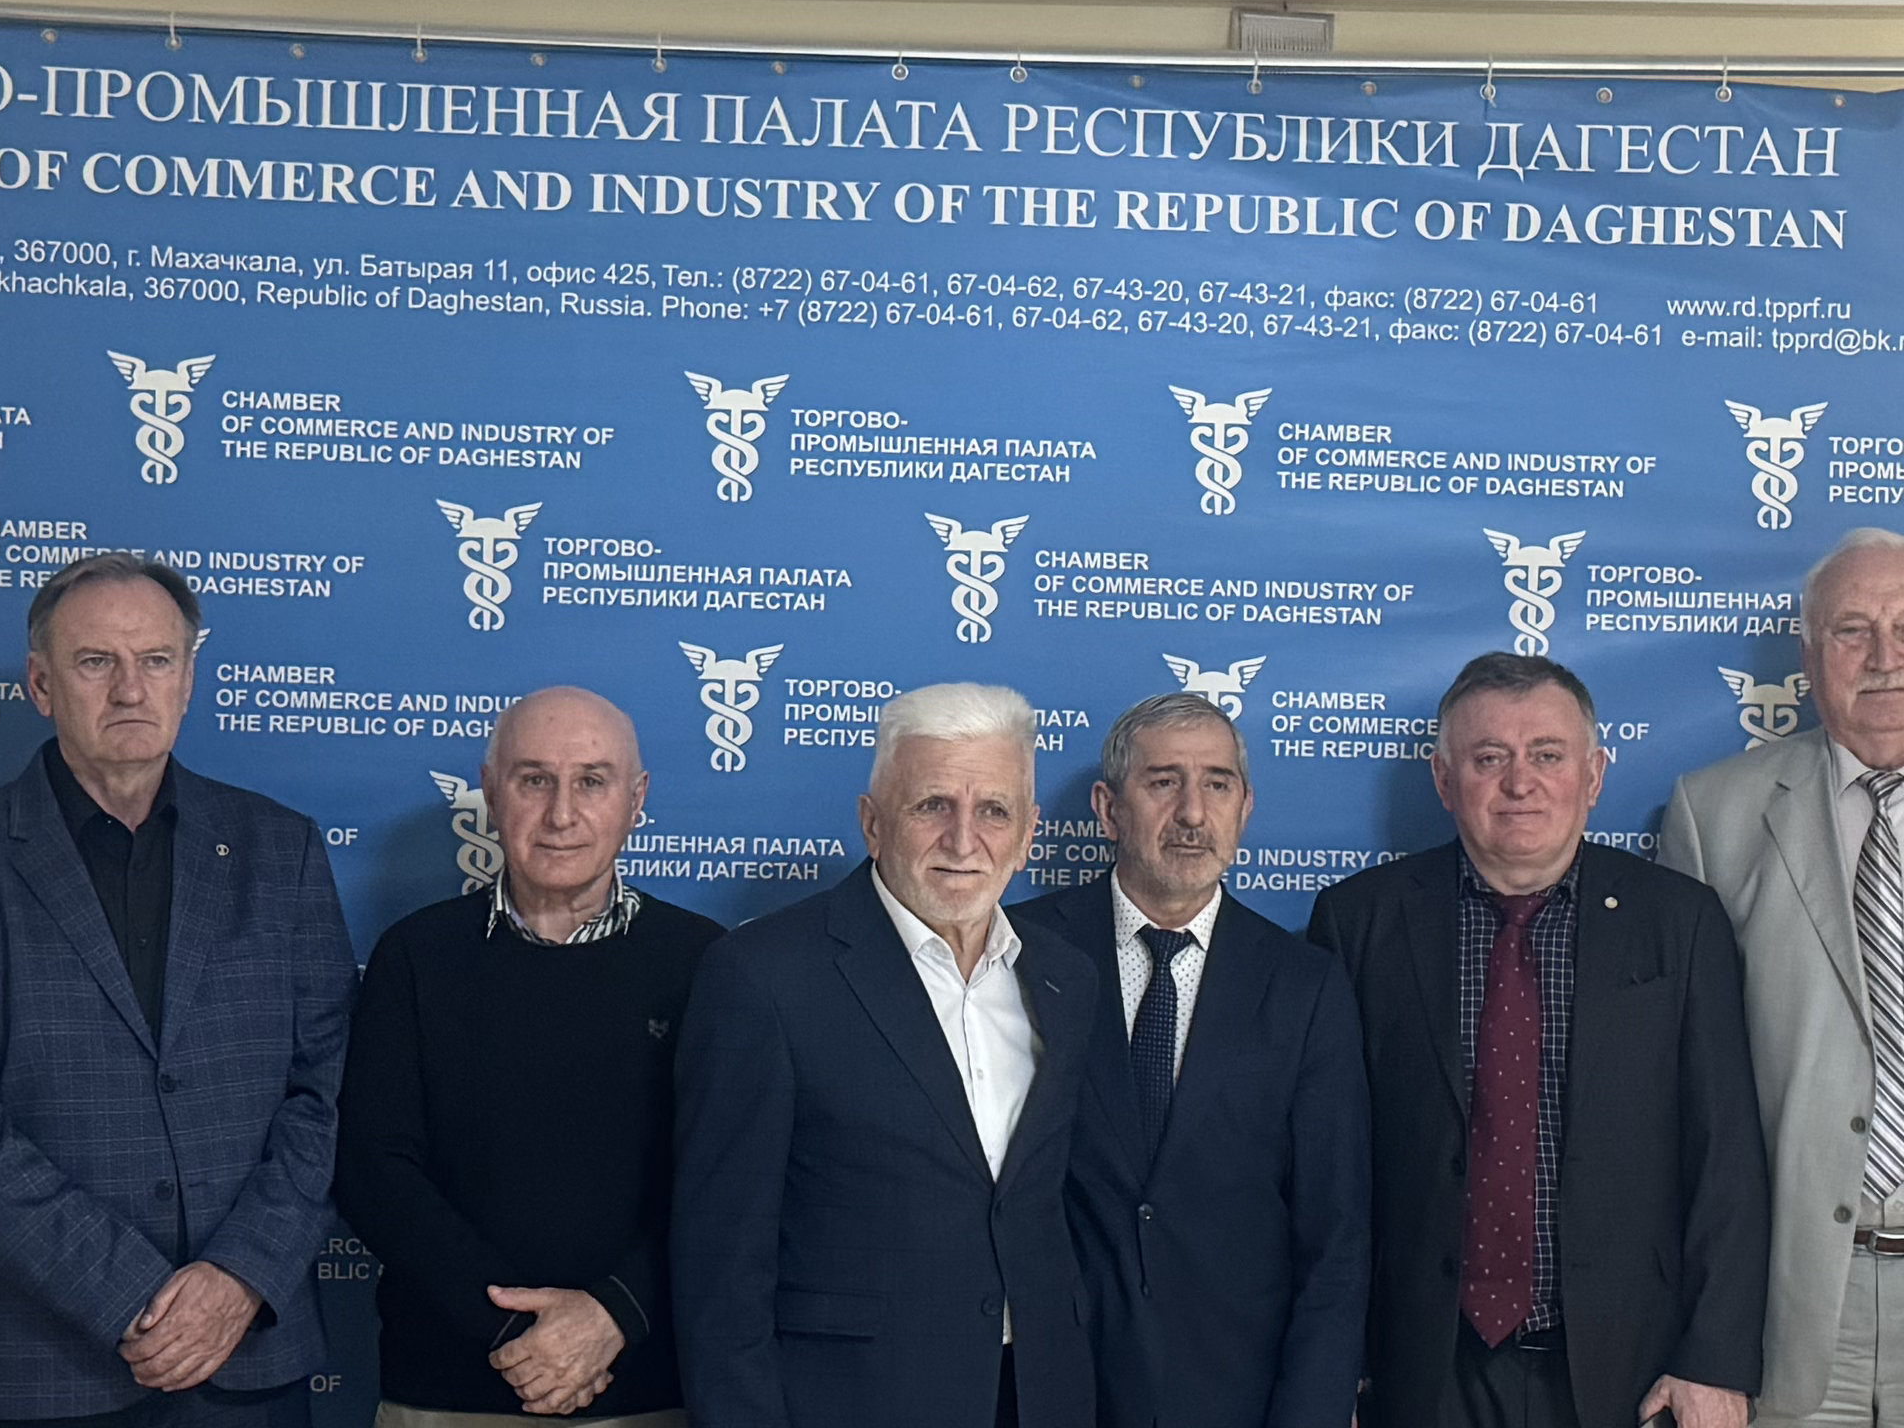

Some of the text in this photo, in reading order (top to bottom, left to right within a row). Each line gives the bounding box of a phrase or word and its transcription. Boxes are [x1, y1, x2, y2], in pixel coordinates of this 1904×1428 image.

[700, 94, 984, 152] ПАЛАТА
[1001, 101, 1460, 168] РЕСПУБЛИКИ
[1476, 118, 1843, 182] ДАГЕСТАН
[82, 152, 437, 207] COMMERCE
[450, 169, 572, 211] AND
[588, 172, 882, 222] INDUSTRY
[894, 182, 970, 224] OF
[982, 185, 1097, 228] THE
[1114, 190, 1398, 239] REPUBLIC
[1414, 200, 1492, 241] OF
[1502, 202, 1848, 250] DAGHESTAN
[14, 238, 118, 270] 367000,
[128, 249, 141, 267] г.
[150, 244, 304, 277] Махачкала,
[312, 258, 350, 280] ул.
[360, 254, 474, 285] Батырая
[484, 258, 518, 285] 11,
[526, 260, 596, 288] офис
[602, 262, 656, 290] 425,
[662, 264, 723, 288] Тел.:
[732, 266, 812, 297] (8722)
[820, 269, 938, 298] 67-04-61,
[946, 272, 1064, 302] 67-04-62,
[1072, 276, 1190, 306] 67-43-20,
[1198, 280, 1316, 310] 67-43-21,
[1324, 284, 1396, 312] факс:
[1404, 286, 1483, 316] (8722)
[1490, 290, 1596, 314] 67-04-61
[1666, 295, 1851, 324] www.rd.tpprf.ru
[144, 276, 246, 306] 367000,
[256, 280, 368, 310] Republic
[374, 286, 401, 308] of
[408, 286, 550, 317] Daghestan,
[560, 292, 652, 317] Russia.
[662, 294, 749, 320] Phone:
[758, 298, 790, 322] +7
[798, 299, 878, 329] (8722)
[886, 302, 1003, 331] 67-04-61,
[1012, 305, 1129, 334] 67-04-62,
[1138, 310, 1254, 339] 67-43-20,
[1263, 313, 1380, 342] 67-43-21,
[1388, 317, 1460, 345] факс:
[1468, 318, 1548, 349] (8722)
[1554, 322, 1661, 346] 67-04-61
[1681, 326, 1763, 348] e-mail:
[222, 390, 342, 412] CHAMBER
[221, 414, 615, 446] OF COMMERCE AND INDUSTRY OF
[790, 408, 908, 430] ТОРГОВО-
[1278, 422, 1392, 444] CHAMBER
[220, 439, 582, 470] THE REPUBLIC OF DAGHESTAN
[790, 432, 1097, 460] ПРОМЫШЛЕННАЯ ПАЛАТА
[790, 457, 1070, 484] РЕСПУБЛИКИ ДАГЕСТАН
[1277, 446, 1657, 474] OF COMMERCE AND INDUSTRY OF
[1276, 470, 1624, 498] THE REPUBLIC OF DAGHESTAN
[543, 536, 662, 558] ТОРГОВО-
[153, 549, 202, 569] AND
[208, 551, 328, 573] INDUSTRY
[332, 554, 366, 574] OF
[1034, 550, 1150, 571] CHAMBER
[187, 575, 331, 598] DAGHESTAN
[543, 561, 852, 588] ПРОМЫШЛЕННАЯ ПАЛАТА
[1586, 564, 1703, 585] ТОРГОВО-
[542, 586, 826, 612] РЕСПУБЛИКИ ДАГЕСТАН
[1034, 574, 1414, 602] OF COMMERCE AND INDUSTRY OF
[1586, 588, 1792, 611] ПРОМЫШЛЕННАЯ
[1033, 598, 1382, 626] THE REPUBLIC OF DAGHESTAN
[1586, 612, 1738, 634] РЕСПУБЛИКИ
[216, 664, 336, 685] CHAMBER
[216, 688, 448, 712] OF COMMERCE AND
[784, 678, 902, 699] ТОРГОВО-
[1272, 690, 1386, 711] CHAMBER
[214, 712, 262, 732] THE
[268, 714, 387, 736] REPUBLIC
[393, 718, 426, 737] OF
[1271, 714, 1303, 733] OF
[1309, 715, 1439, 736] COMMERCE
[1619, 722, 1650, 741] OF
[1270, 738, 1316, 758] THE
[326, 826, 359, 847] OF
[622, 834, 846, 857] ШЛЕННАЯ ПАЛАТА
[1027, 844, 1058, 862] OF
[1258, 848, 1372, 870] INDUSTRY
[614, 858, 818, 882] БЛИКИ ДАГЕСТАН
[1027, 867, 1072, 886] THE
[309, 1375, 342, 1393] OF
